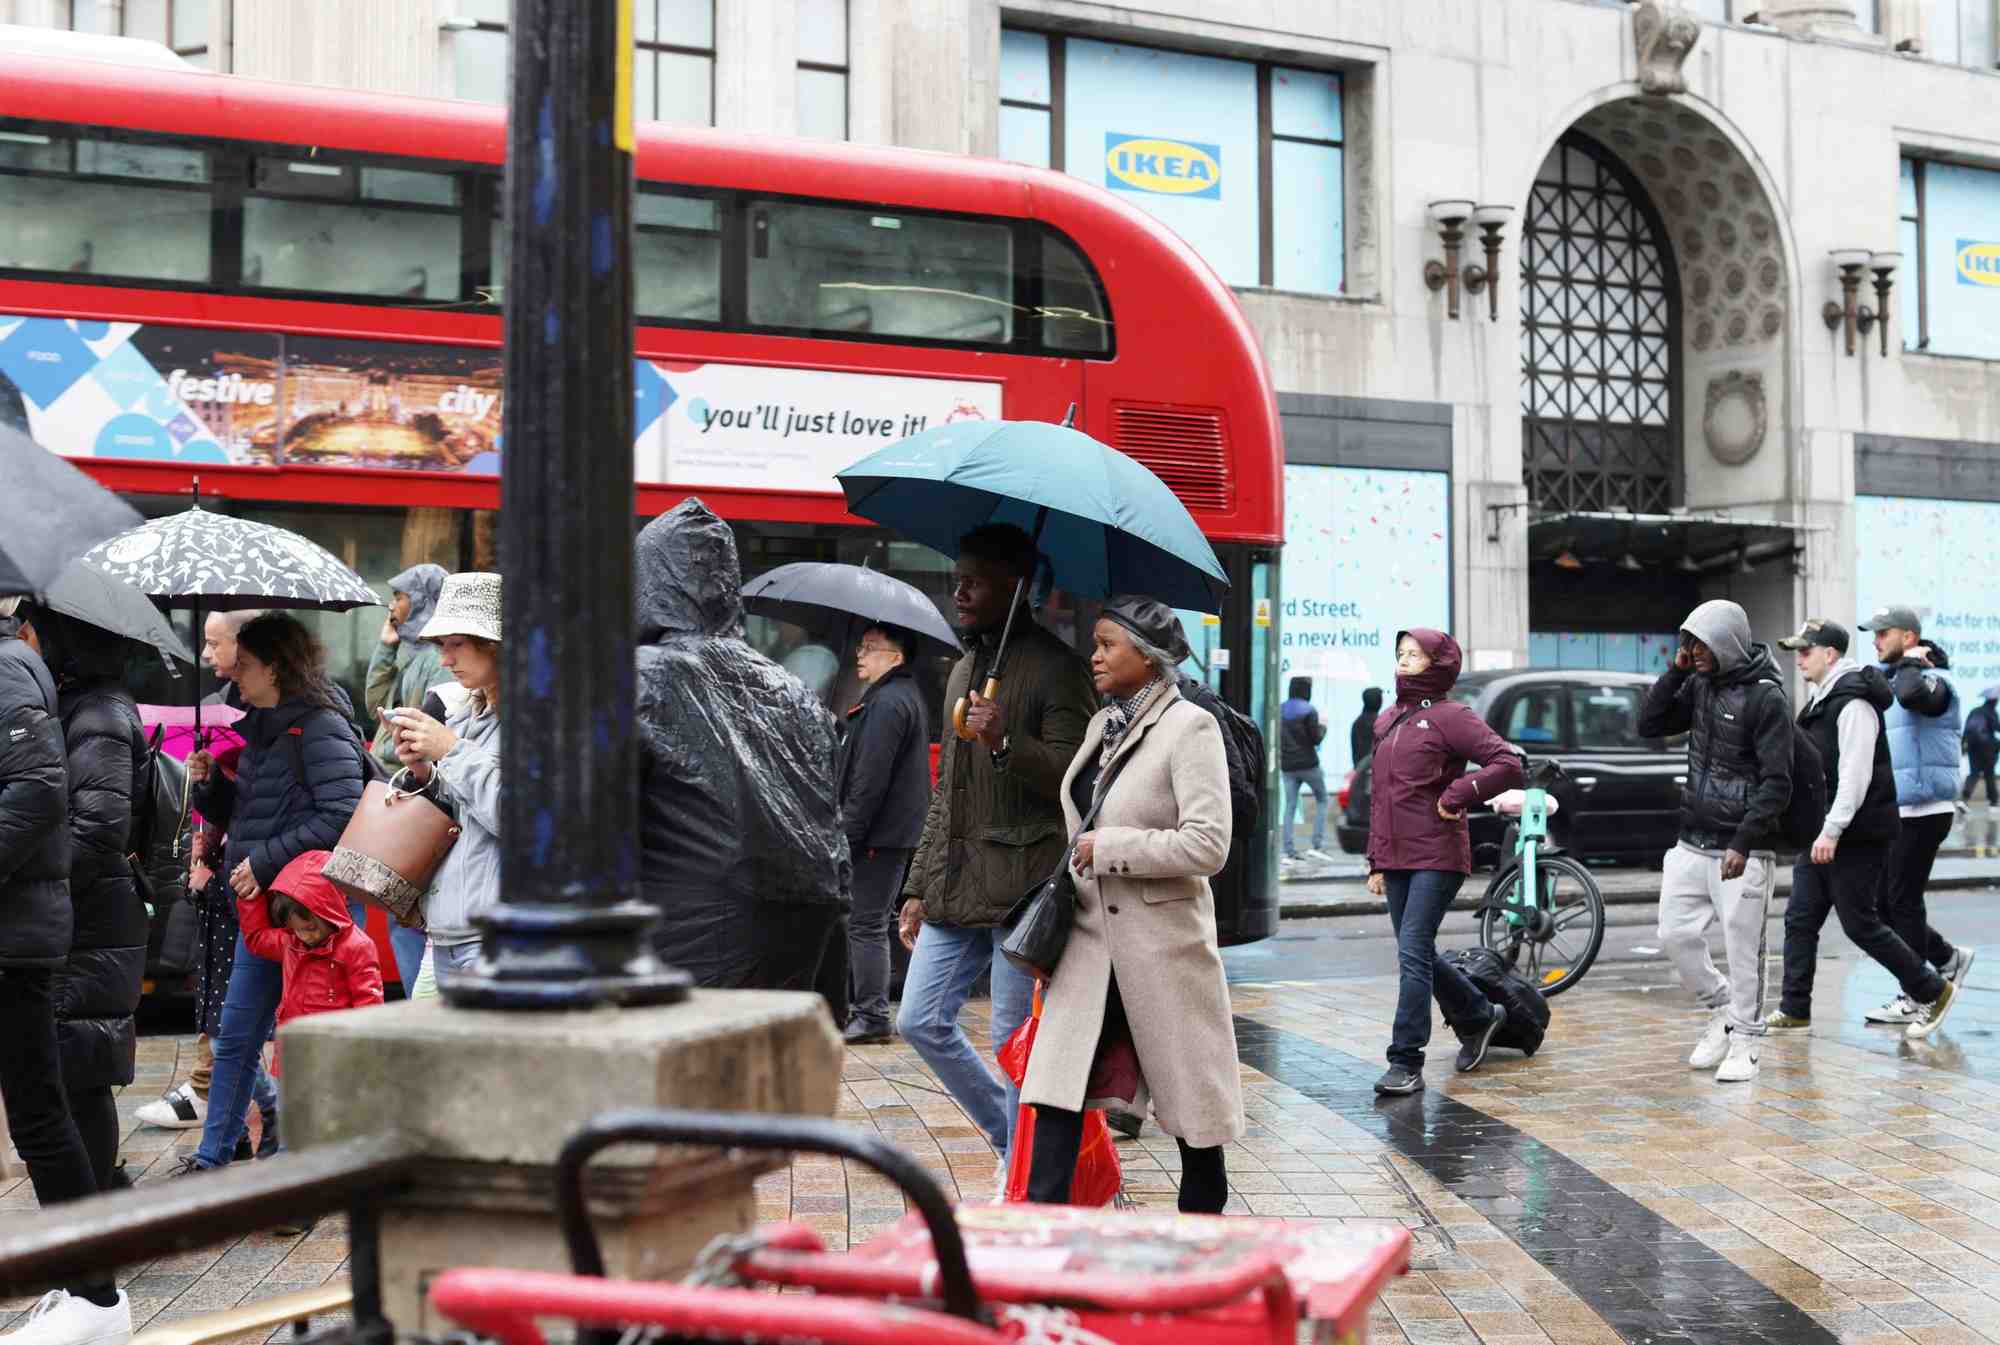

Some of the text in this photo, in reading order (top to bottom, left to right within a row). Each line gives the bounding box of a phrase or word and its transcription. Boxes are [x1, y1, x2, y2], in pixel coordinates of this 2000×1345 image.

[1118, 152, 1211, 180] IKEA
[167, 368, 274, 406] festive
[438, 384, 498, 421] city
[701, 404, 780, 434] you'll
[783, 406, 836, 438] just
[841, 410, 894, 437] love
[1302, 599, 1361, 620] Street,
[1282, 627, 1380, 648] a new kind
